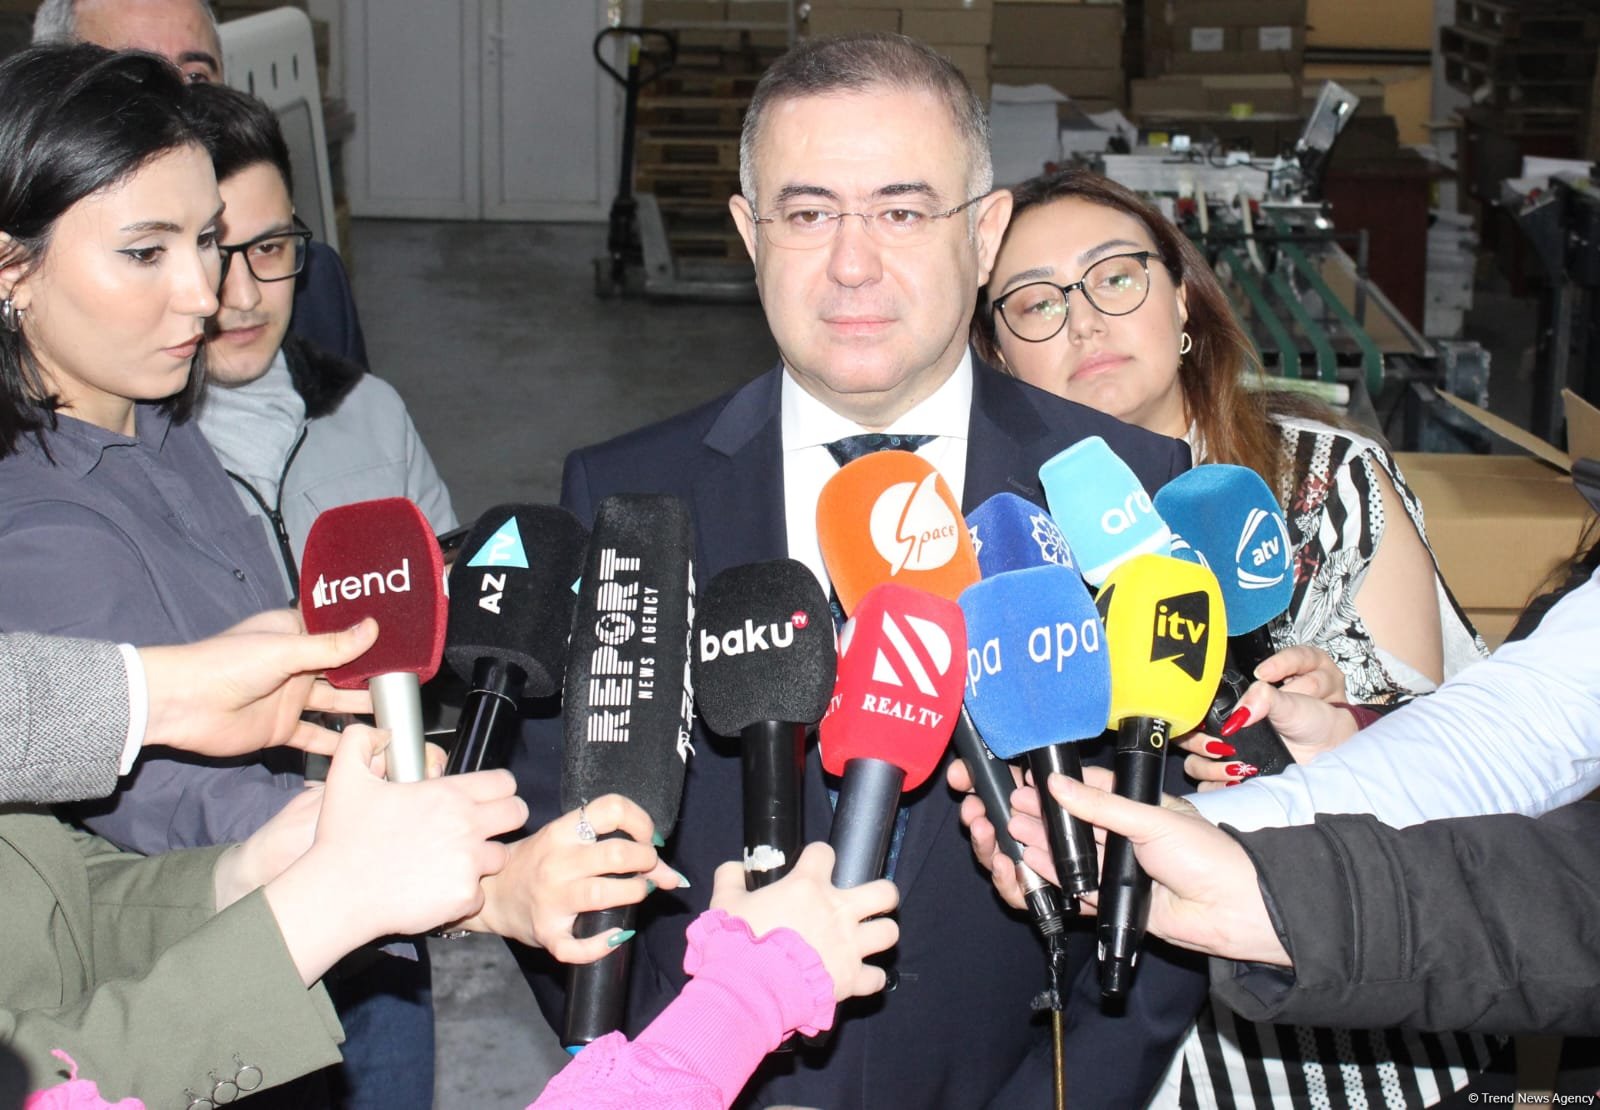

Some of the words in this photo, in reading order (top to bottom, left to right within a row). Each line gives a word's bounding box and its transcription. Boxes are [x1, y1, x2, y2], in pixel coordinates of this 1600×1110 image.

[1252, 539, 1279, 566] atv
[312, 558, 411, 608] trend
[479, 573, 506, 614] AZ
[641, 587, 660, 644] AGENCY
[700, 619, 794, 662] baku
[793, 615, 807, 625] TV
[1157, 605, 1206, 643] itv
[588, 548, 641, 742] REPORT
[966, 637, 1002, 697] pa
[1028, 619, 1098, 672] apa
[638, 656, 655, 700] NEWS
[862, 693, 918, 722] REAL
[918, 708, 944, 729] TV
